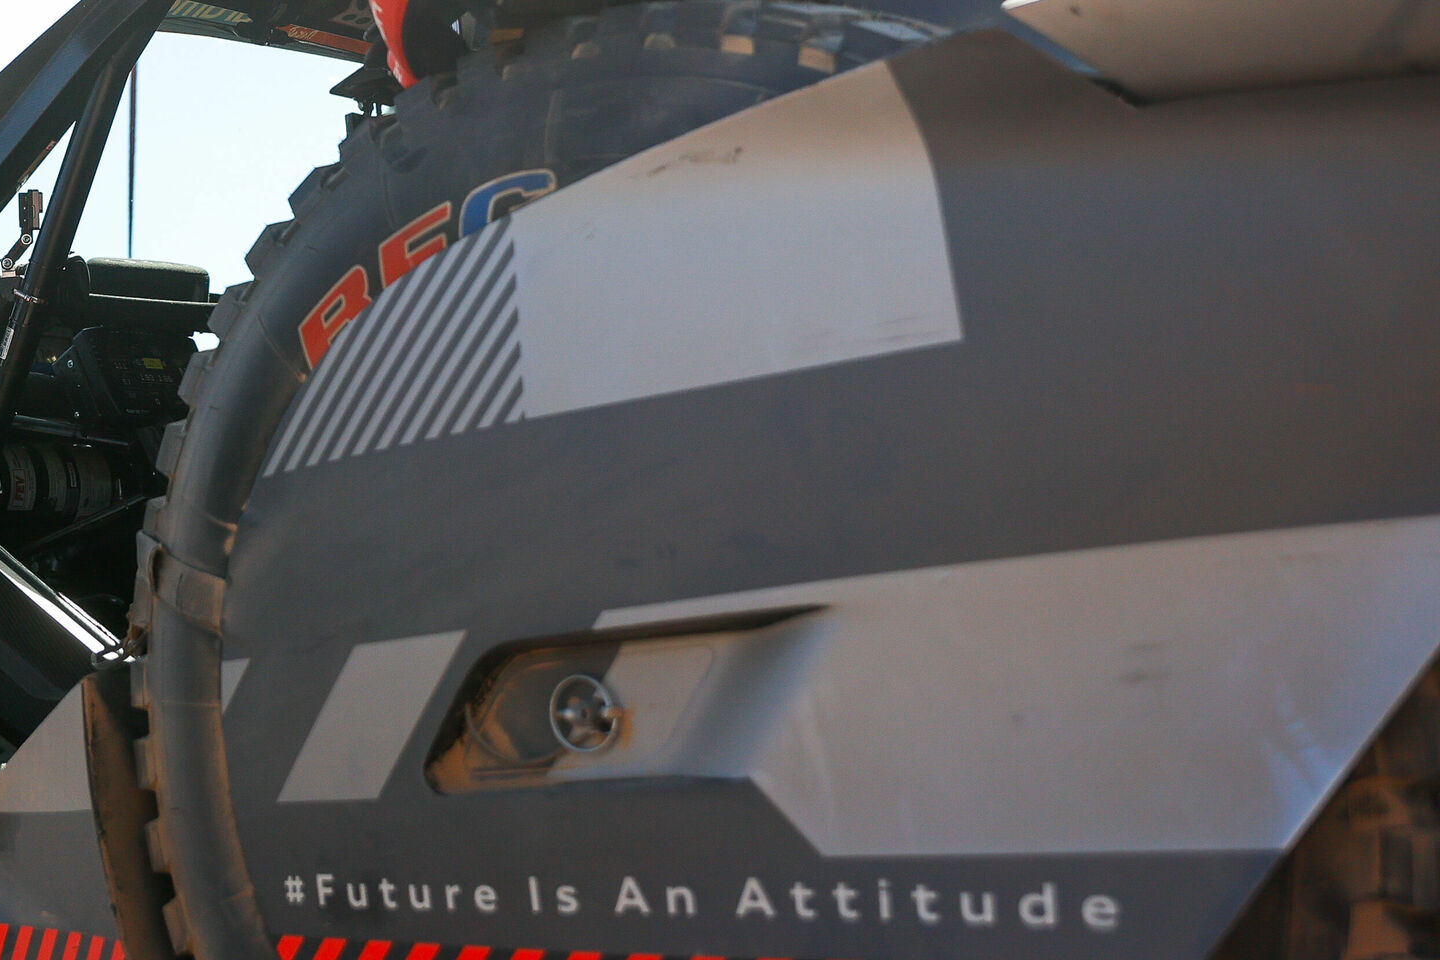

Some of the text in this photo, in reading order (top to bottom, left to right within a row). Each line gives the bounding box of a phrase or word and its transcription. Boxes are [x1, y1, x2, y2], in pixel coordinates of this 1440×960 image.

[283, 873, 1121, 930] #Future Is An Attitude
